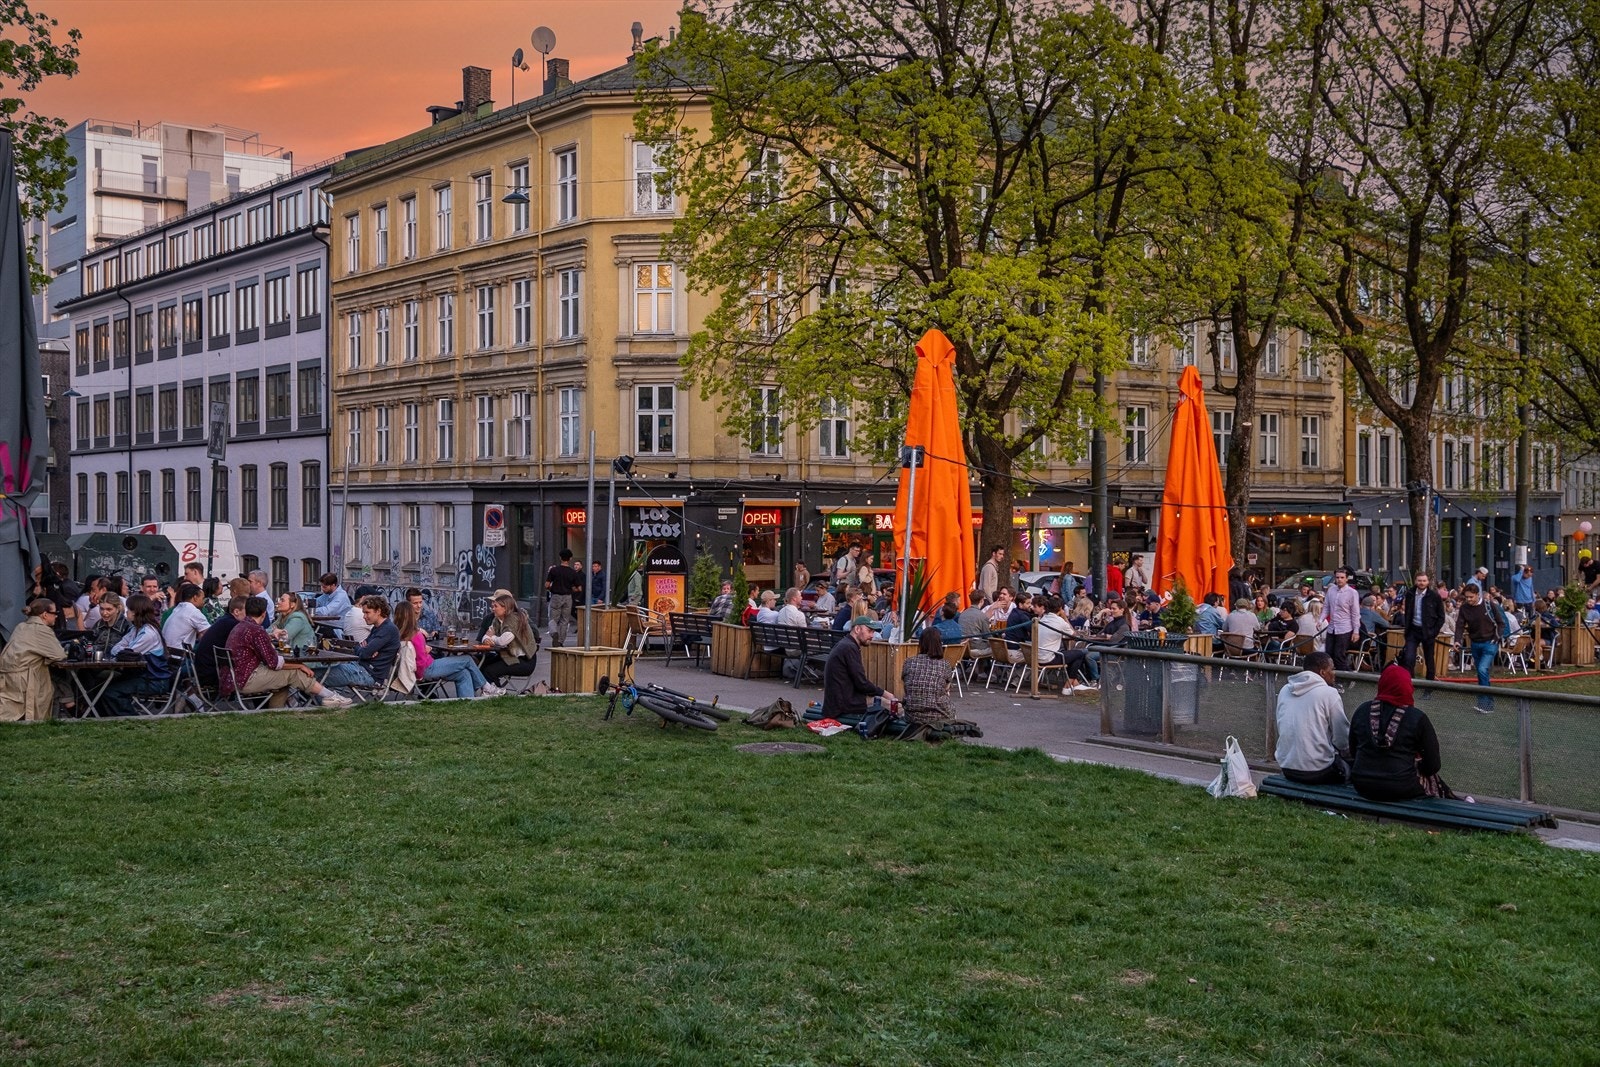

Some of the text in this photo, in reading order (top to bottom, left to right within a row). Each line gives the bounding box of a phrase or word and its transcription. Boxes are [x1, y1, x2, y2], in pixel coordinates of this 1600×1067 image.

[640, 507, 670, 521] LOS
[744, 512, 777, 525] OPEN
[1048, 515, 1074, 525] TACOS
[831, 517, 862, 526] NACHOS
[875, 514, 896, 529] BA
[630, 522, 682, 538] TACOS
[651, 558, 681, 566] LOS TACOS
